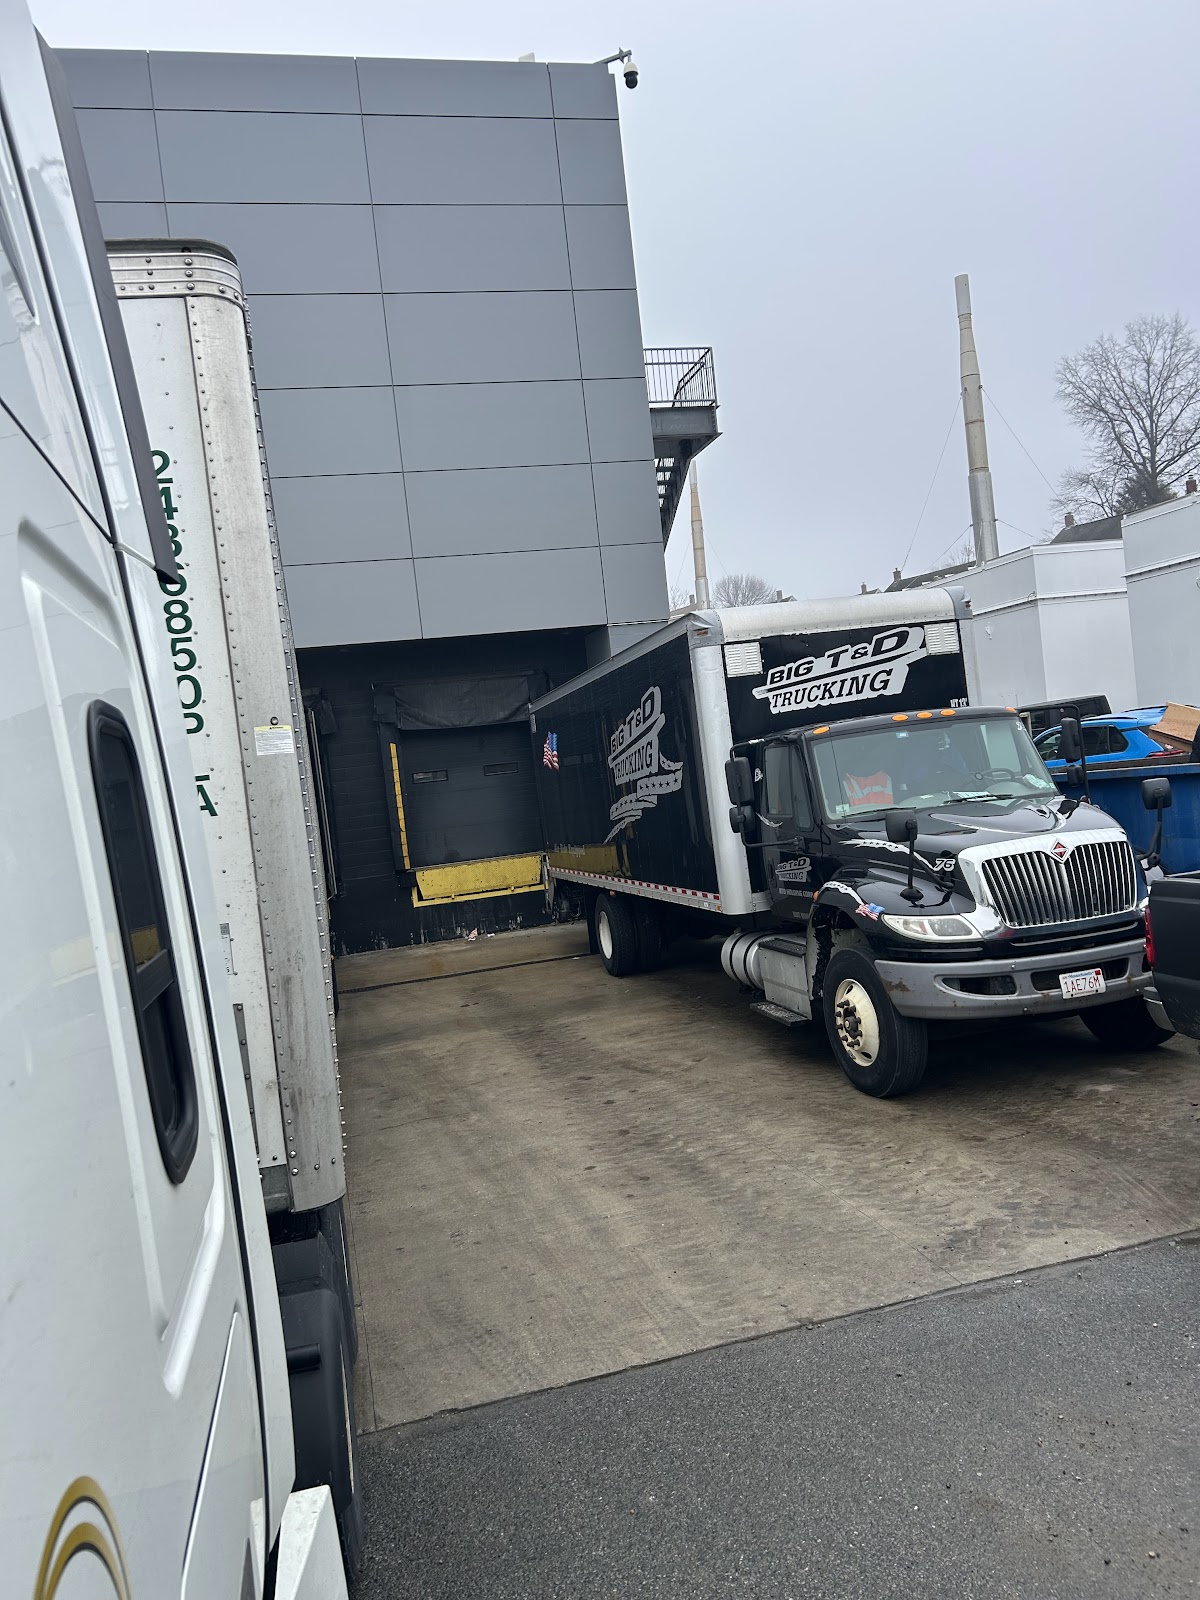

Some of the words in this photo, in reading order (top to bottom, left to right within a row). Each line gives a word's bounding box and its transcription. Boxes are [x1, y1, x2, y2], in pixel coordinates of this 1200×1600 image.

[768, 659, 814, 686] BIG
[826, 630, 911, 668] T&D
[770, 667, 895, 709] TRUCKING
[611, 732, 625, 753] BIG
[627, 688, 656, 738] T&D
[613, 739, 653, 781] TRUCKING
[1063, 976, 1101, 994] 1AE76M
